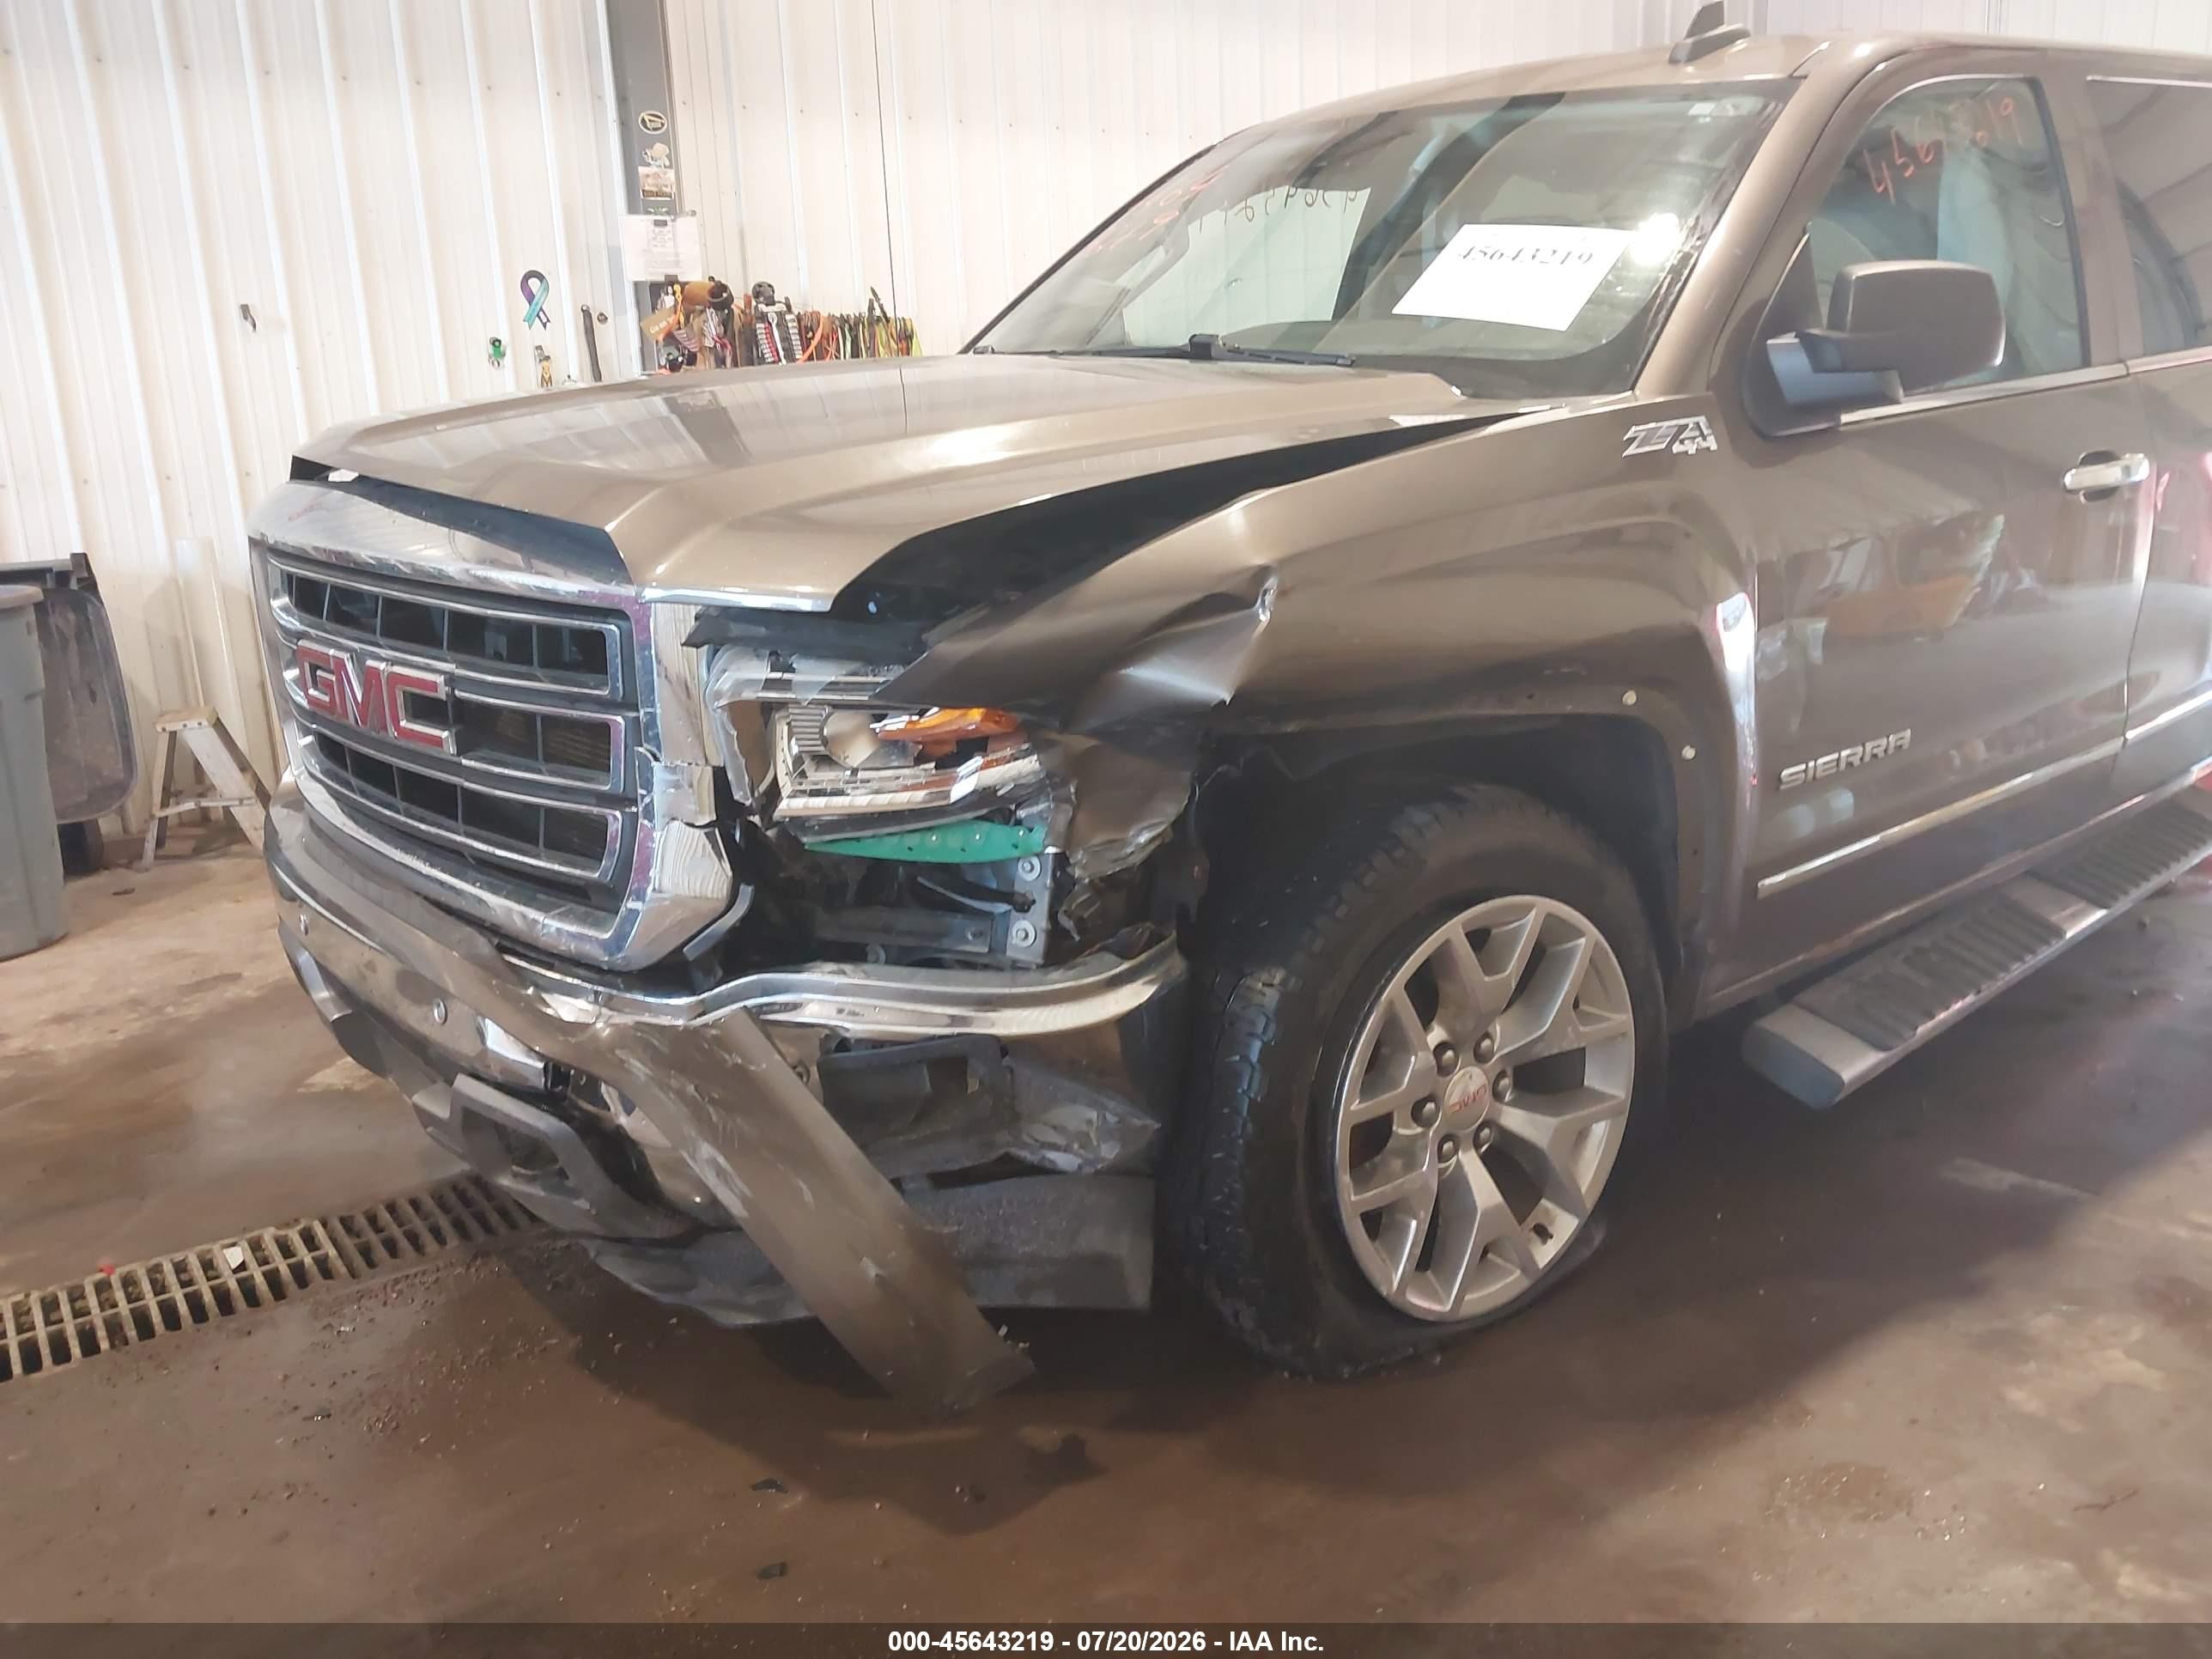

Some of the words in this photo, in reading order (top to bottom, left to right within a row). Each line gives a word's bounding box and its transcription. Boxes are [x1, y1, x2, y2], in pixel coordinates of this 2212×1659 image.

[295, 639, 458, 756] GMC
[1778, 728, 1911, 790] SIERRA
[1448, 1083, 1486, 1114] GMC
